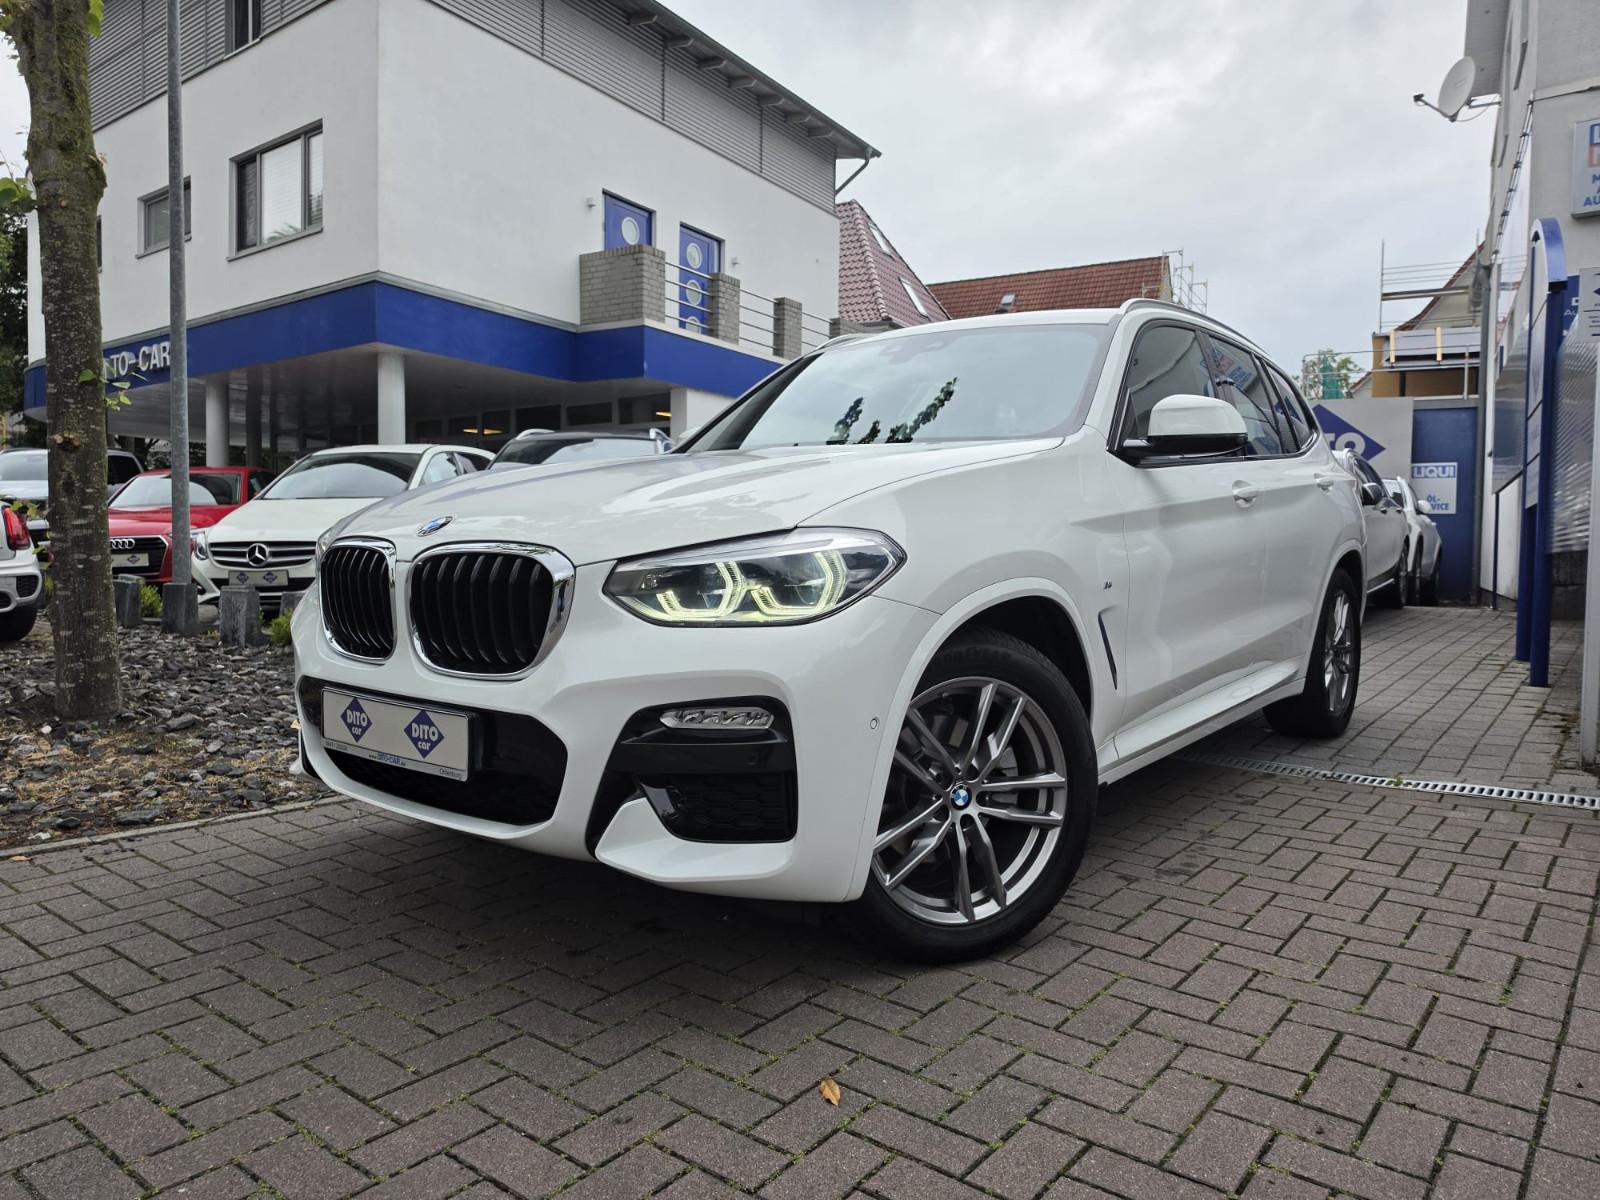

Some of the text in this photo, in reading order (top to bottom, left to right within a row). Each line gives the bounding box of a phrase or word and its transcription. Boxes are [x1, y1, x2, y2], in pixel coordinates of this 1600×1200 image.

[1413, 466, 1454, 478] LIQUI
[1430, 503, 1449, 511] VICE
[346, 710, 368, 728] DITO
[352, 726, 362, 735] car
[411, 722, 439, 740] DITO
[417, 740, 431, 751] car
